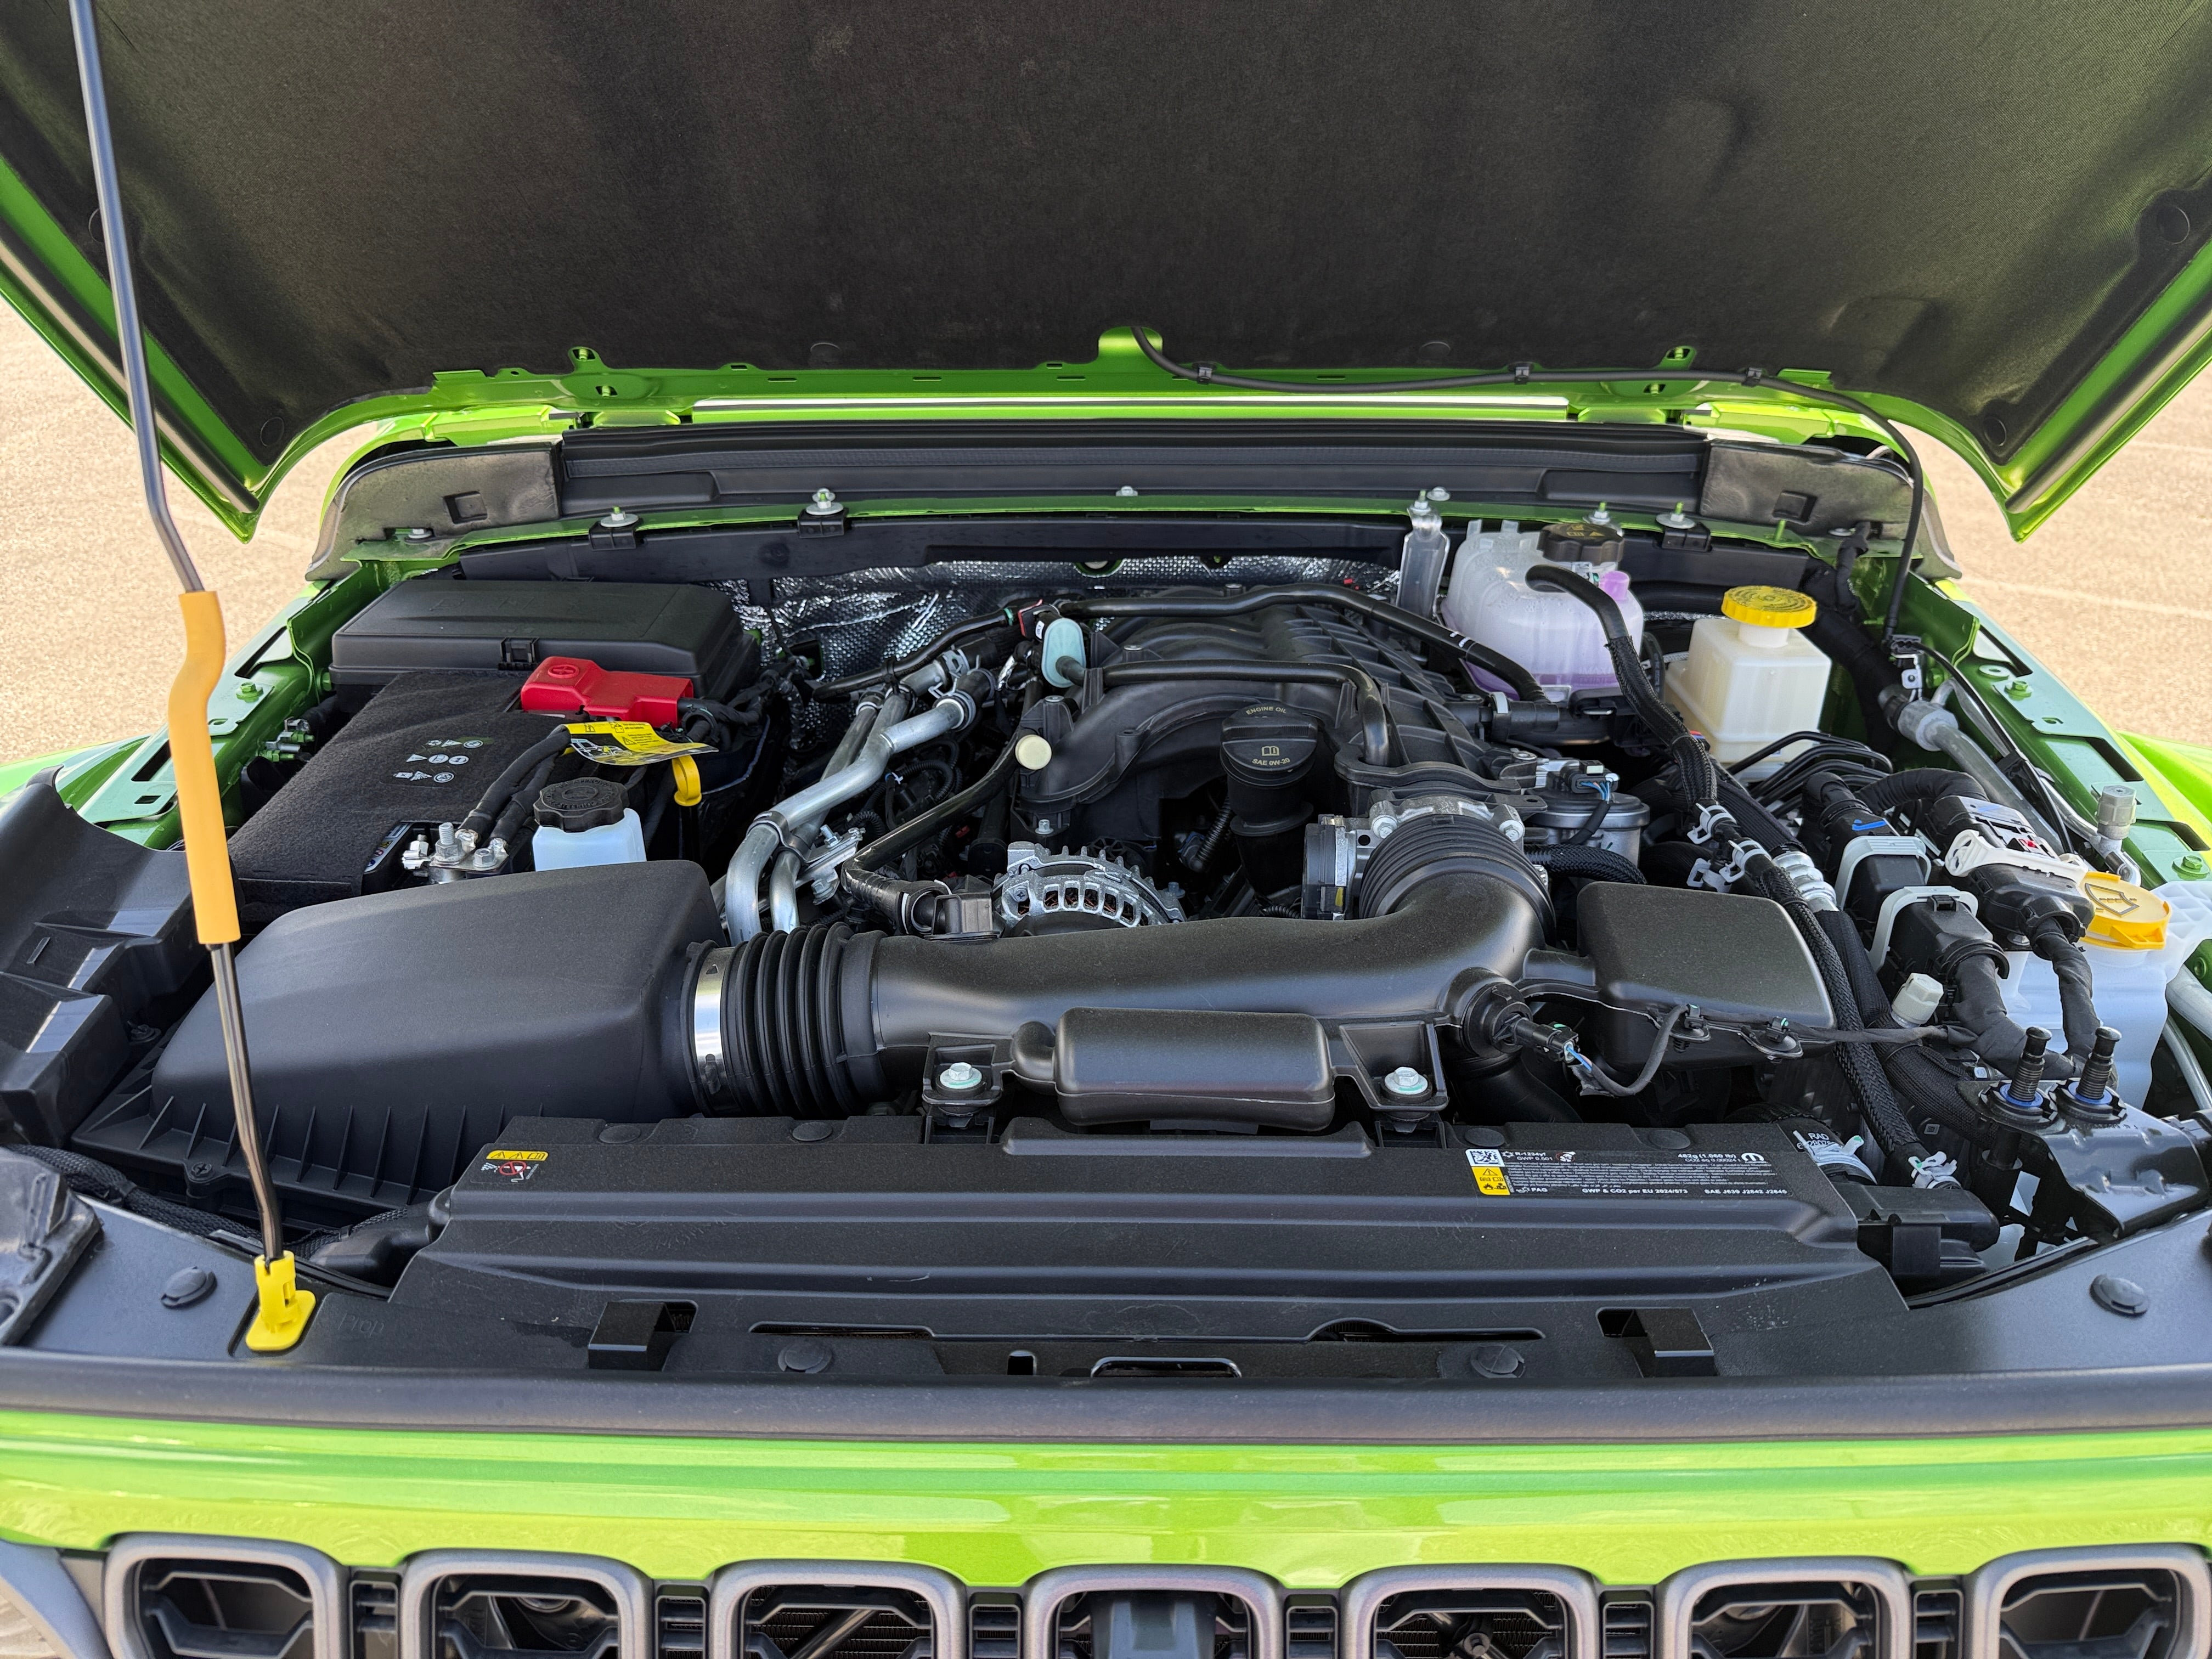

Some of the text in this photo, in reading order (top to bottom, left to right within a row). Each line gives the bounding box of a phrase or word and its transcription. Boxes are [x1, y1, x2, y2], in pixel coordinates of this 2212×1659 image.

[1246, 706, 1274, 715] ENGINE
[1252, 757, 1290, 766] SAE 0W-20
[1808, 1132, 1830, 1141] RAD
